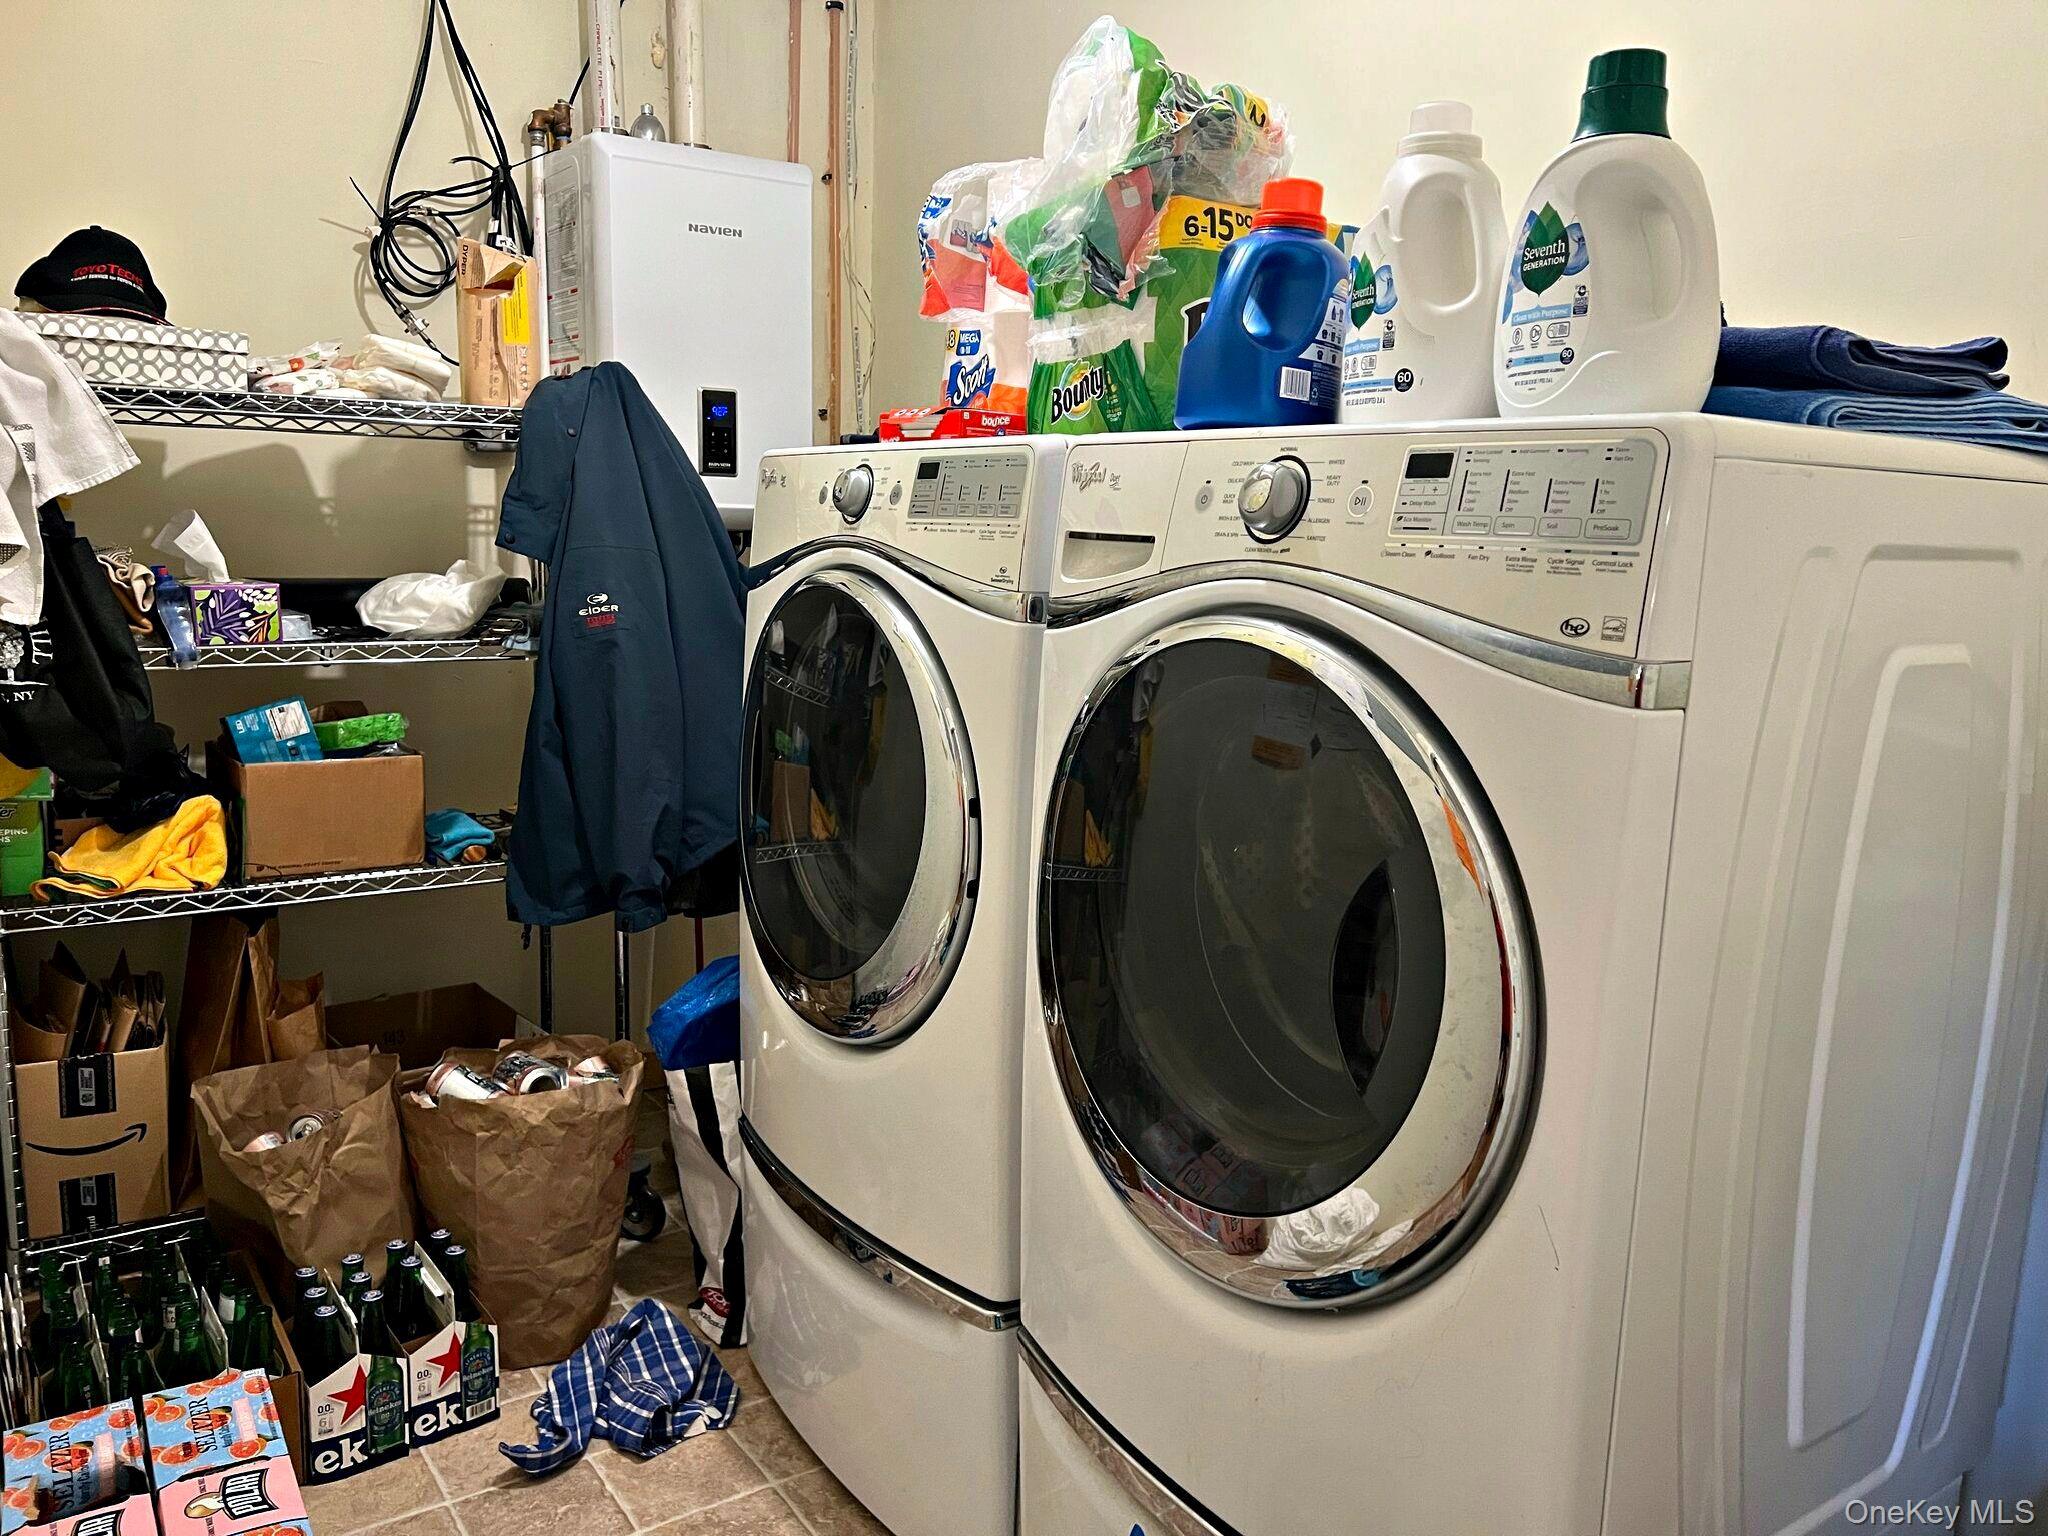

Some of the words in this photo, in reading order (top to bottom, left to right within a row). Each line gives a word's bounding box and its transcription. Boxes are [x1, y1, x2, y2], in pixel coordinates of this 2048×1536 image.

[1523, 239, 1566, 261] Seventh
[1523, 256, 1566, 272] GENERATION
[959, 332, 980, 343] MEGA
[1562, 350, 1573, 358] 60
[953, 354, 989, 405] Scott
[1397, 371, 1412, 382] 60
[1050, 366, 1104, 424] Bounty
[981, 415, 1010, 427] bounce
[1547, 558, 1564, 566] Cycle
[1565, 558, 1586, 566] Signal
[1591, 559, 1617, 567] Control
[1617, 560, 1634, 568] Lock
[13, 690, 35, 702] NY
[189, 1397, 218, 1454] SELTZER
[414, 1400, 463, 1437] ek
[314, 1437, 368, 1474] ek
[225, 1472, 269, 1517] POLAR
